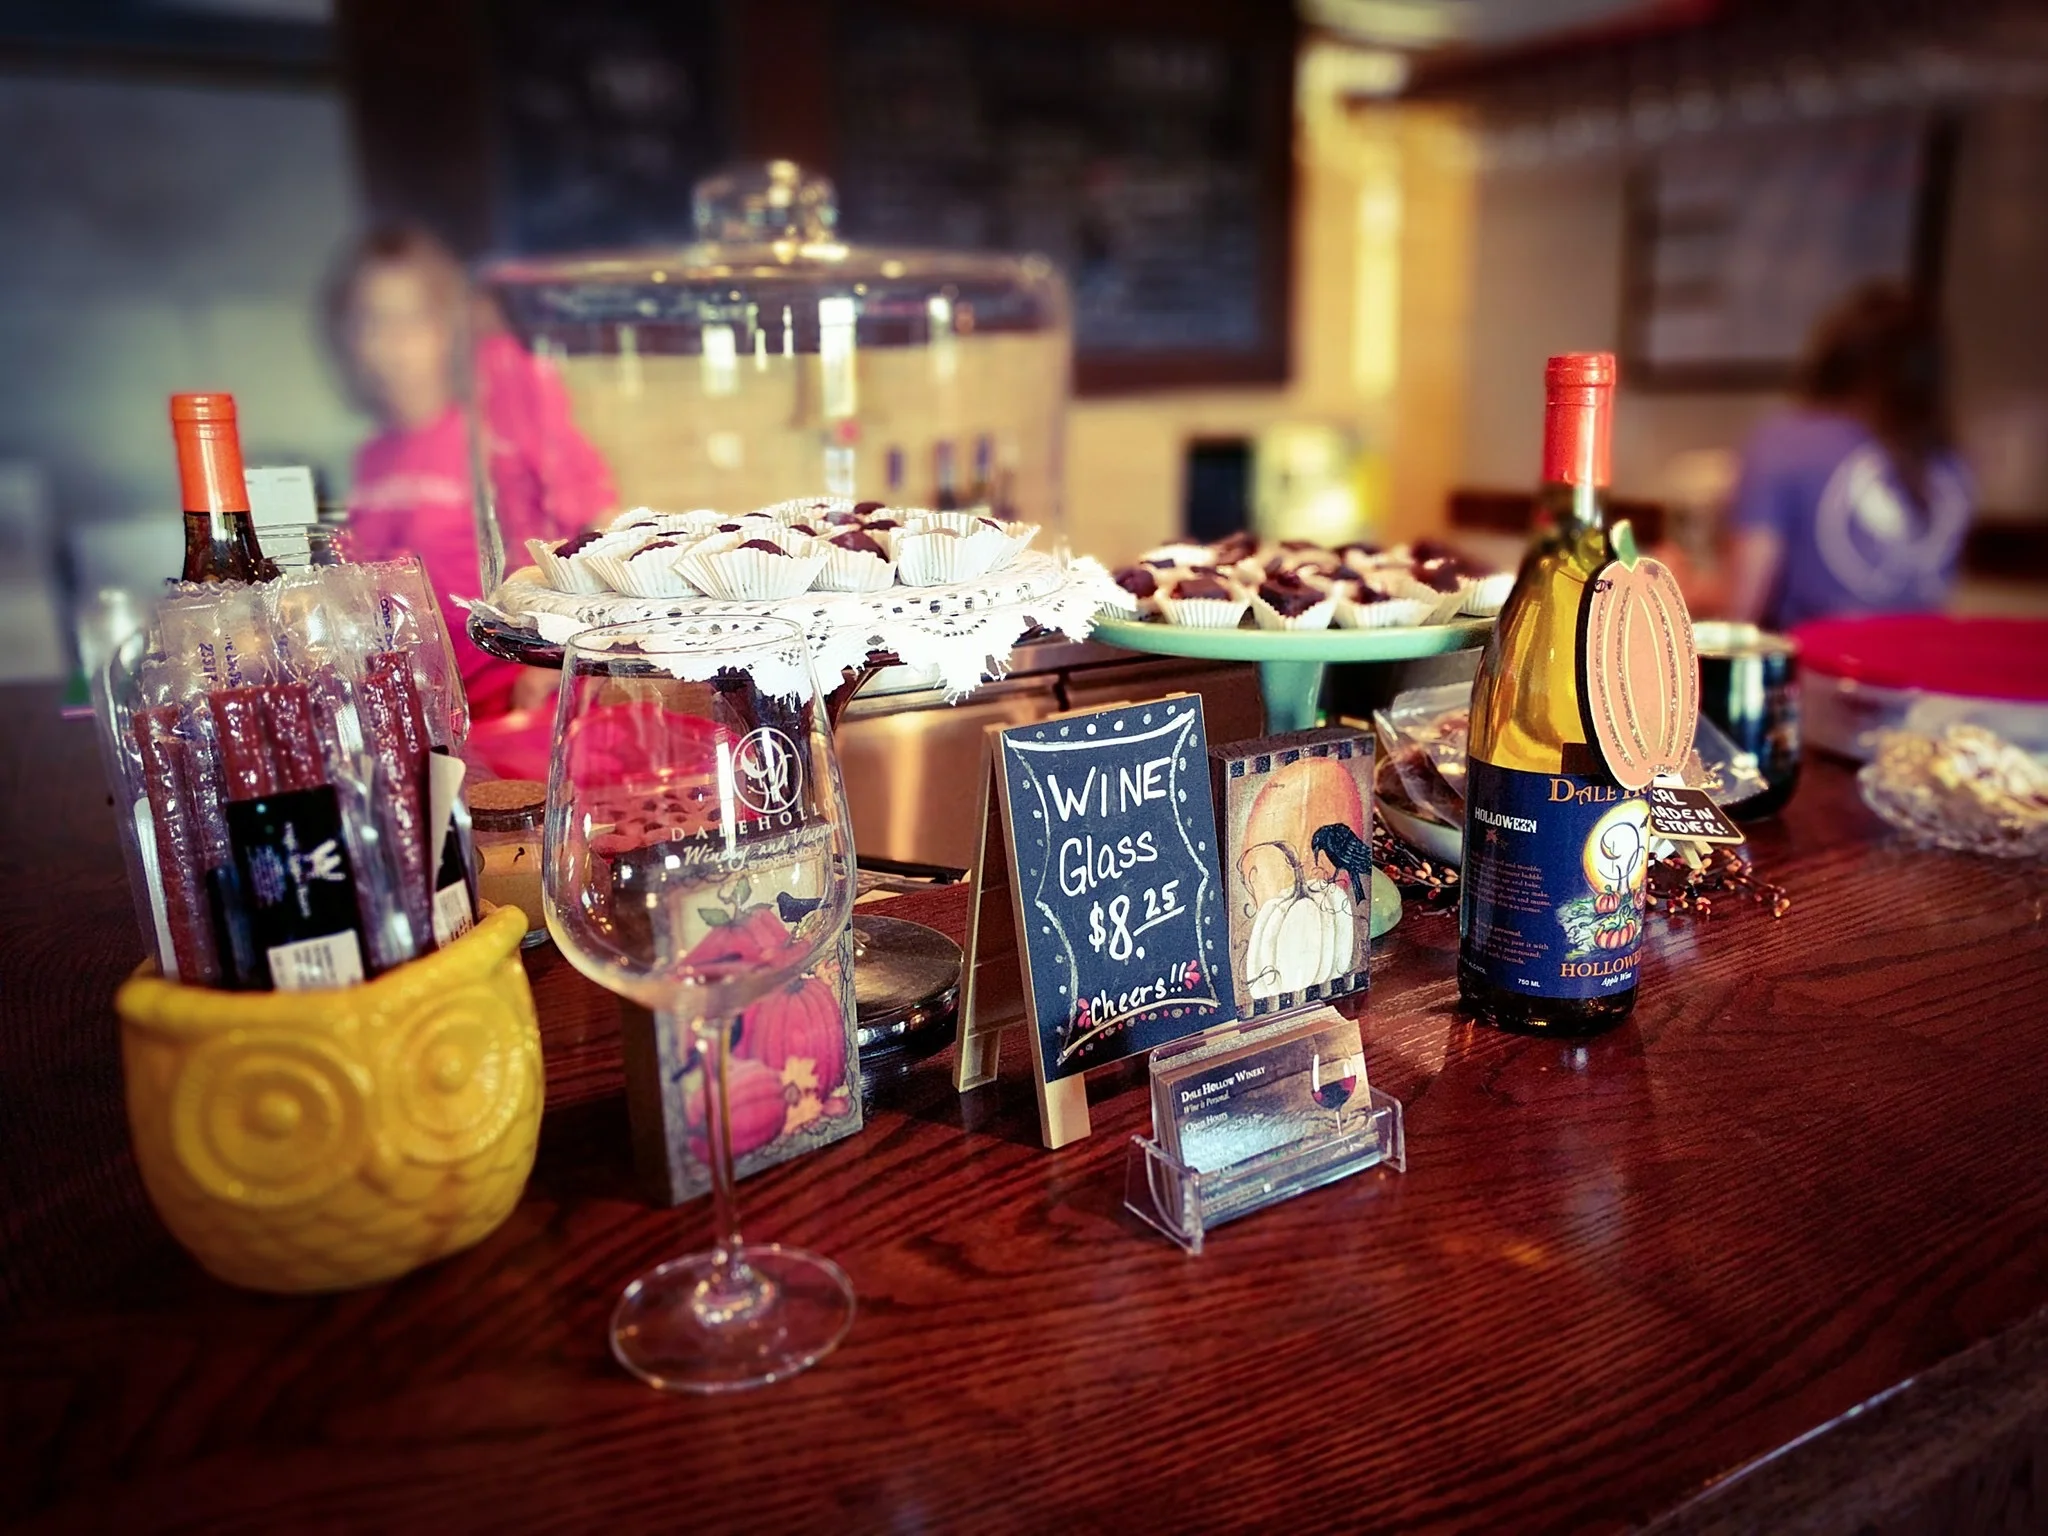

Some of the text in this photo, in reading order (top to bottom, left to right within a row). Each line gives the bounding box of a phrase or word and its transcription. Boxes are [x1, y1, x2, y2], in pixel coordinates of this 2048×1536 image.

[1047, 757, 1172, 821] WINE
[1548, 778, 1617, 806] DALE
[1652, 788, 1687, 805] CAL
[1694, 807, 1715, 821] IN
[758, 836, 789, 855] and
[1059, 831, 1159, 897] Glass
[1560, 948, 1642, 977] HOLLOWE
[1517, 978, 1541, 988] 750 ML
[1601, 975, 1619, 987] Apple
[1090, 961, 1187, 1027] Cheers!!
